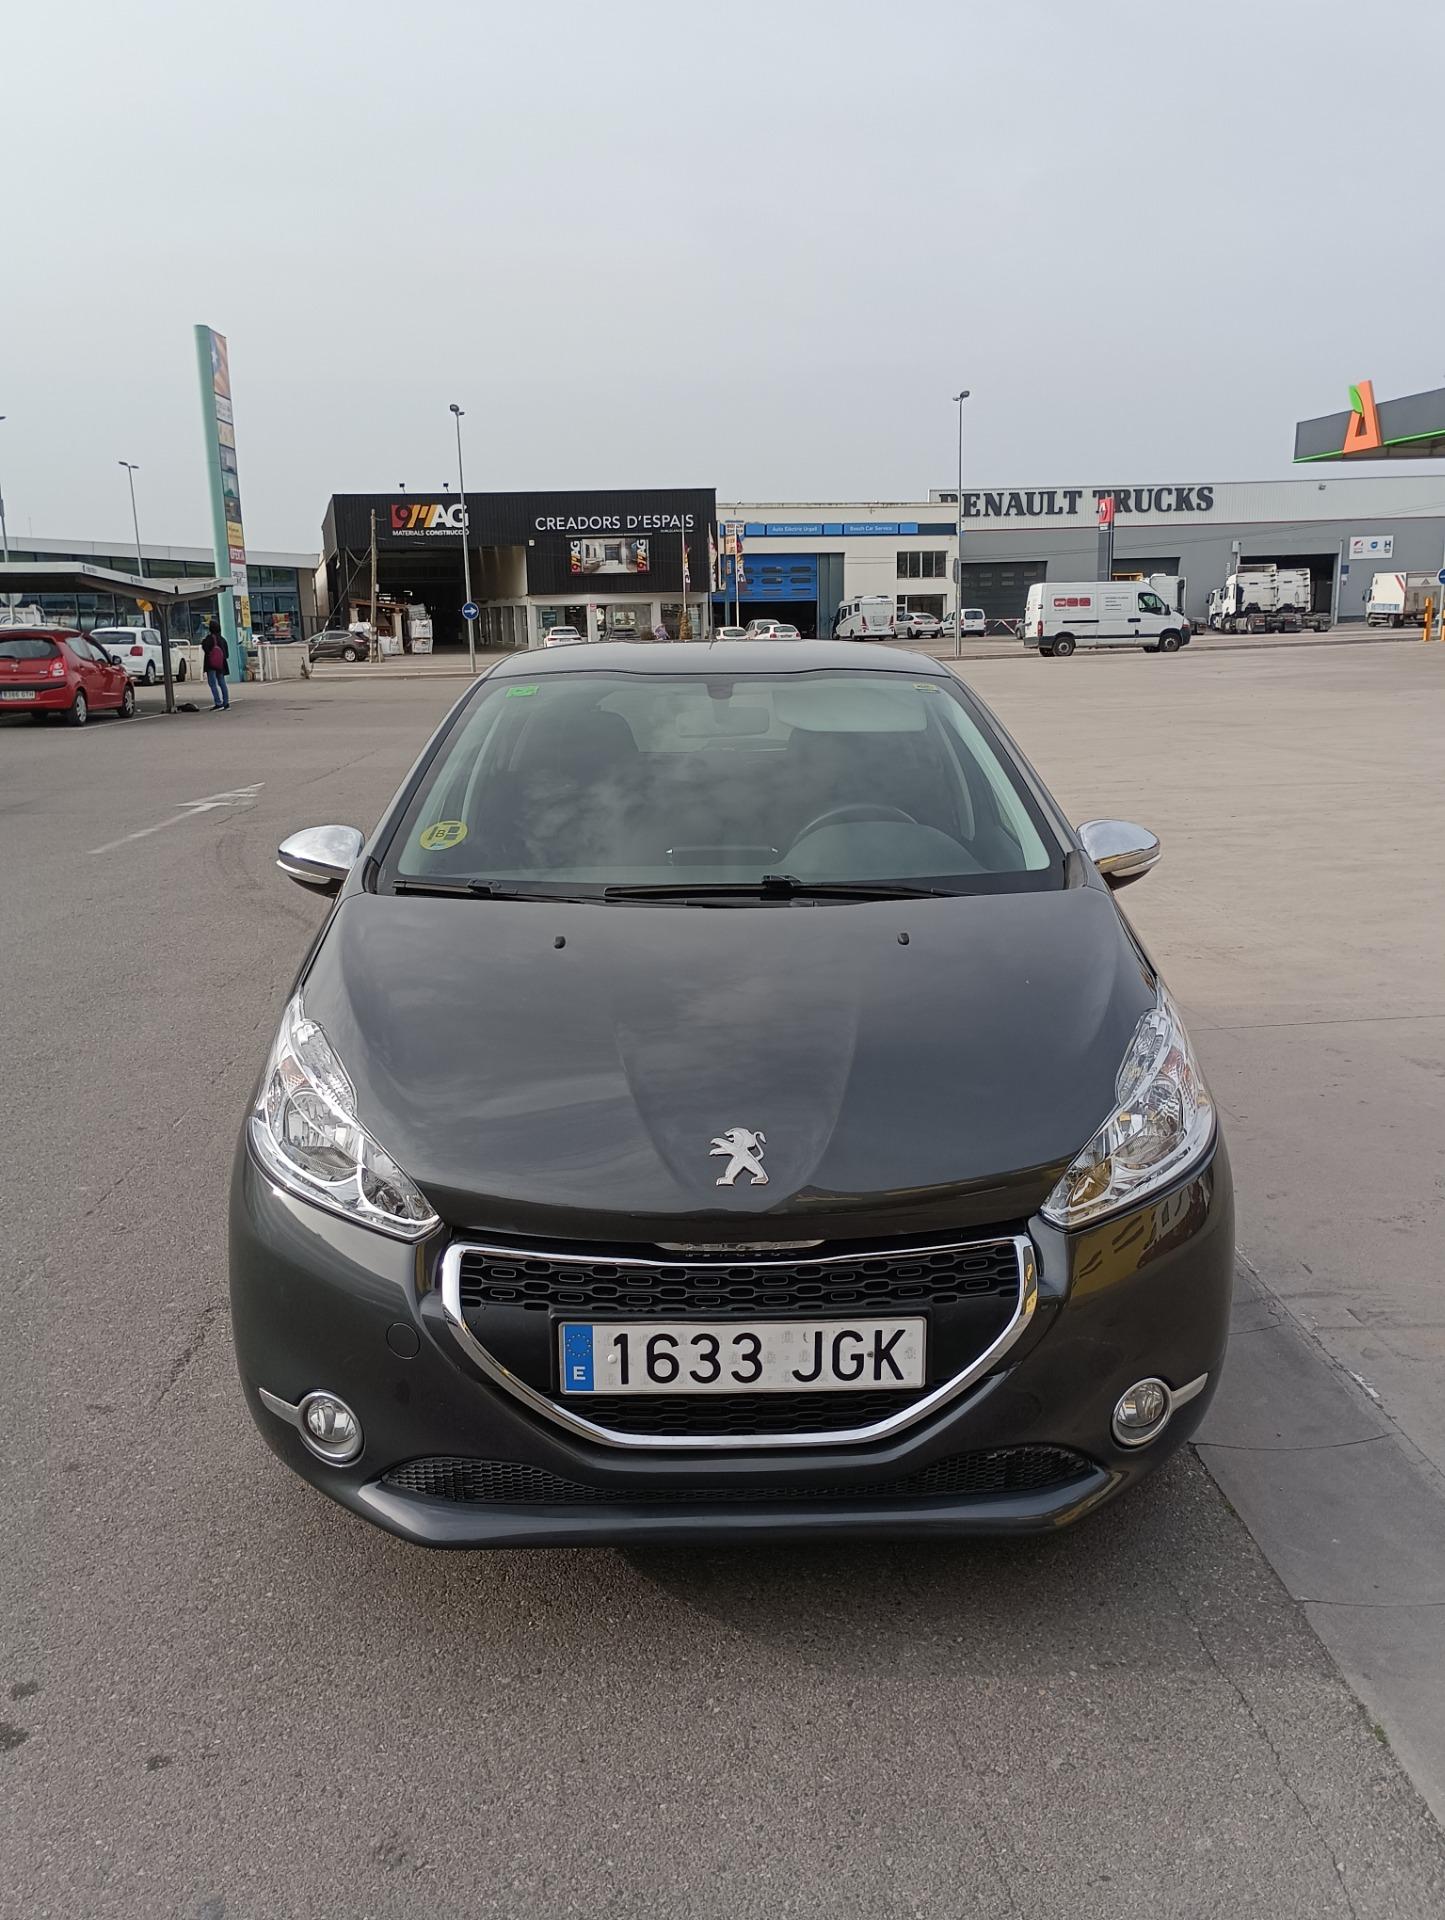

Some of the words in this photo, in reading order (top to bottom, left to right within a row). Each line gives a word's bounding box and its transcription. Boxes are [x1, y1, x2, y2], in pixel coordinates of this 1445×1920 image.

[535, 515, 621, 531] CREADORS
[572, 1366, 586, 1380] E
[613, 1332, 763, 1385] 1633
[792, 1328, 906, 1383] JGK
